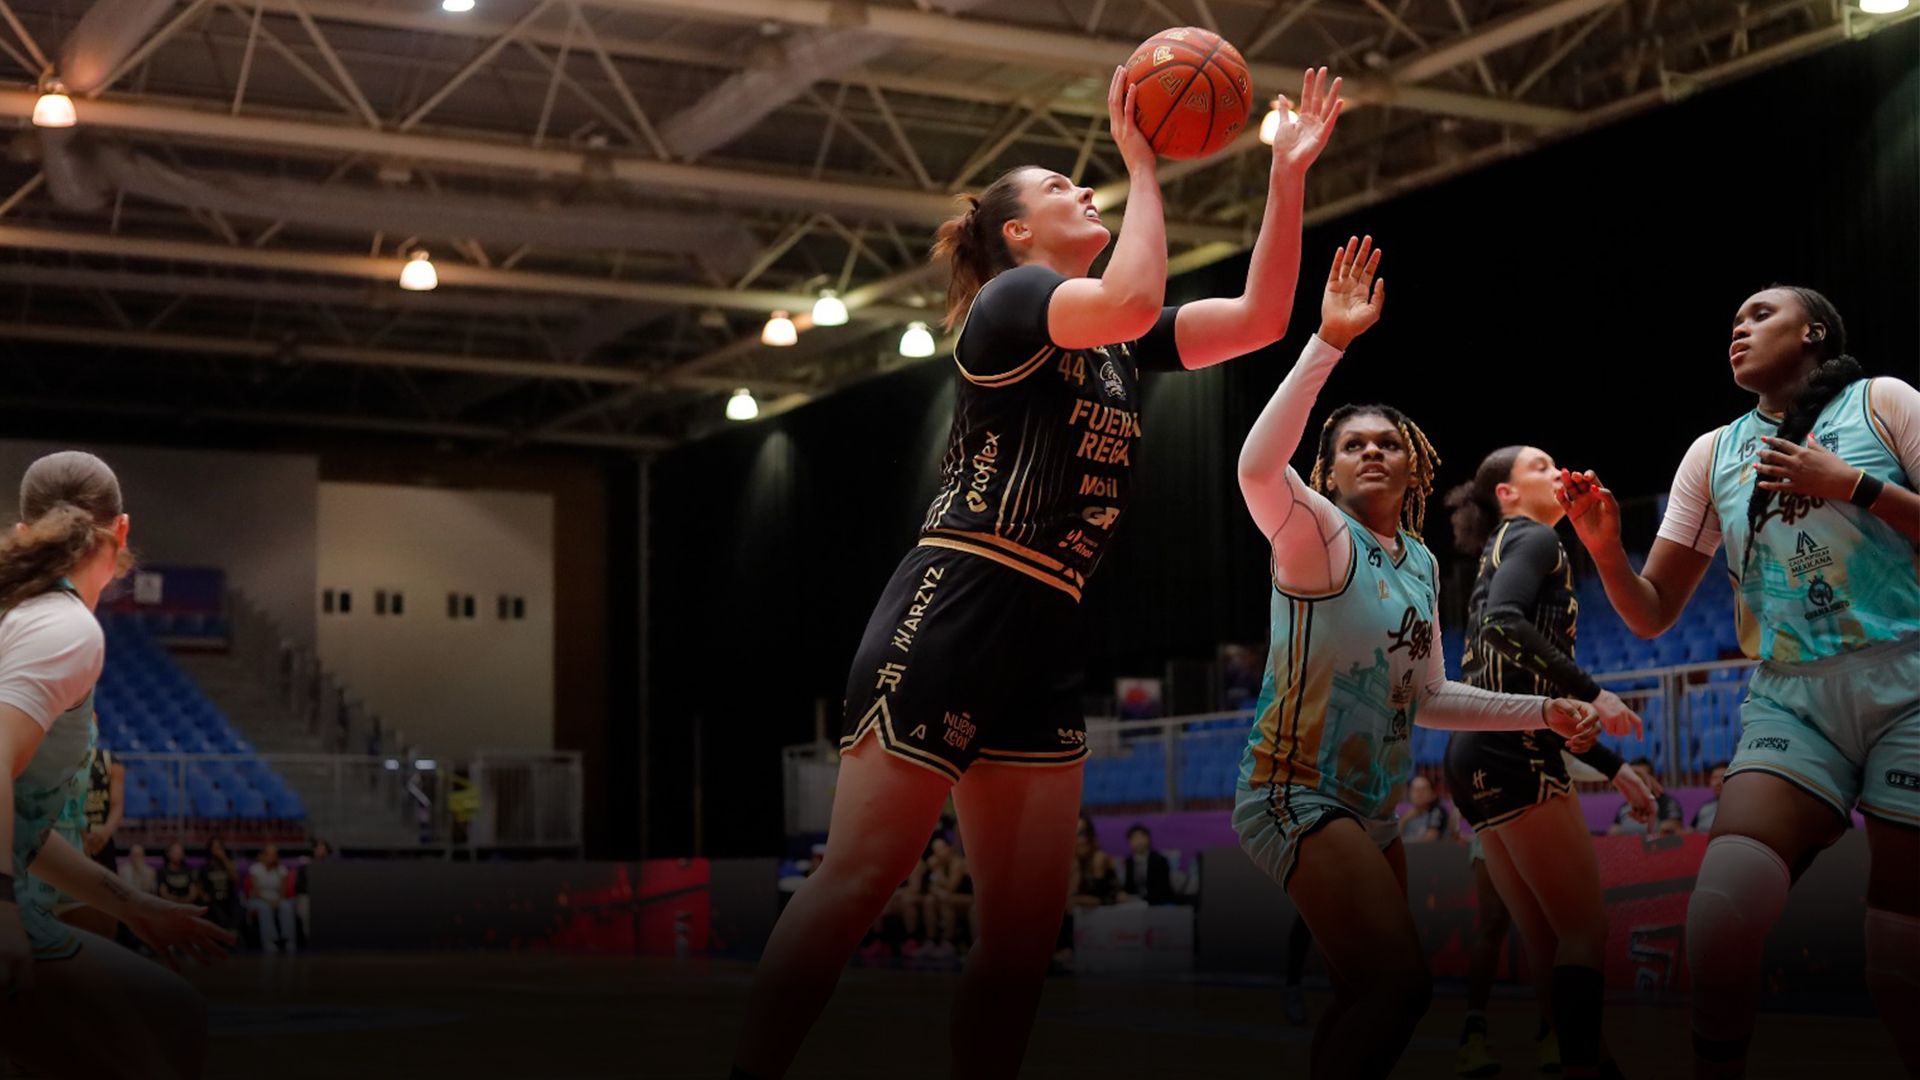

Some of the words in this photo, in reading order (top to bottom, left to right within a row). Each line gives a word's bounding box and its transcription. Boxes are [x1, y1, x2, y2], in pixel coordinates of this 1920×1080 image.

[1058, 352, 1087, 386] 44
[972, 431, 1000, 491] coflex
[1791, 556, 1833, 573] MEXICANA
